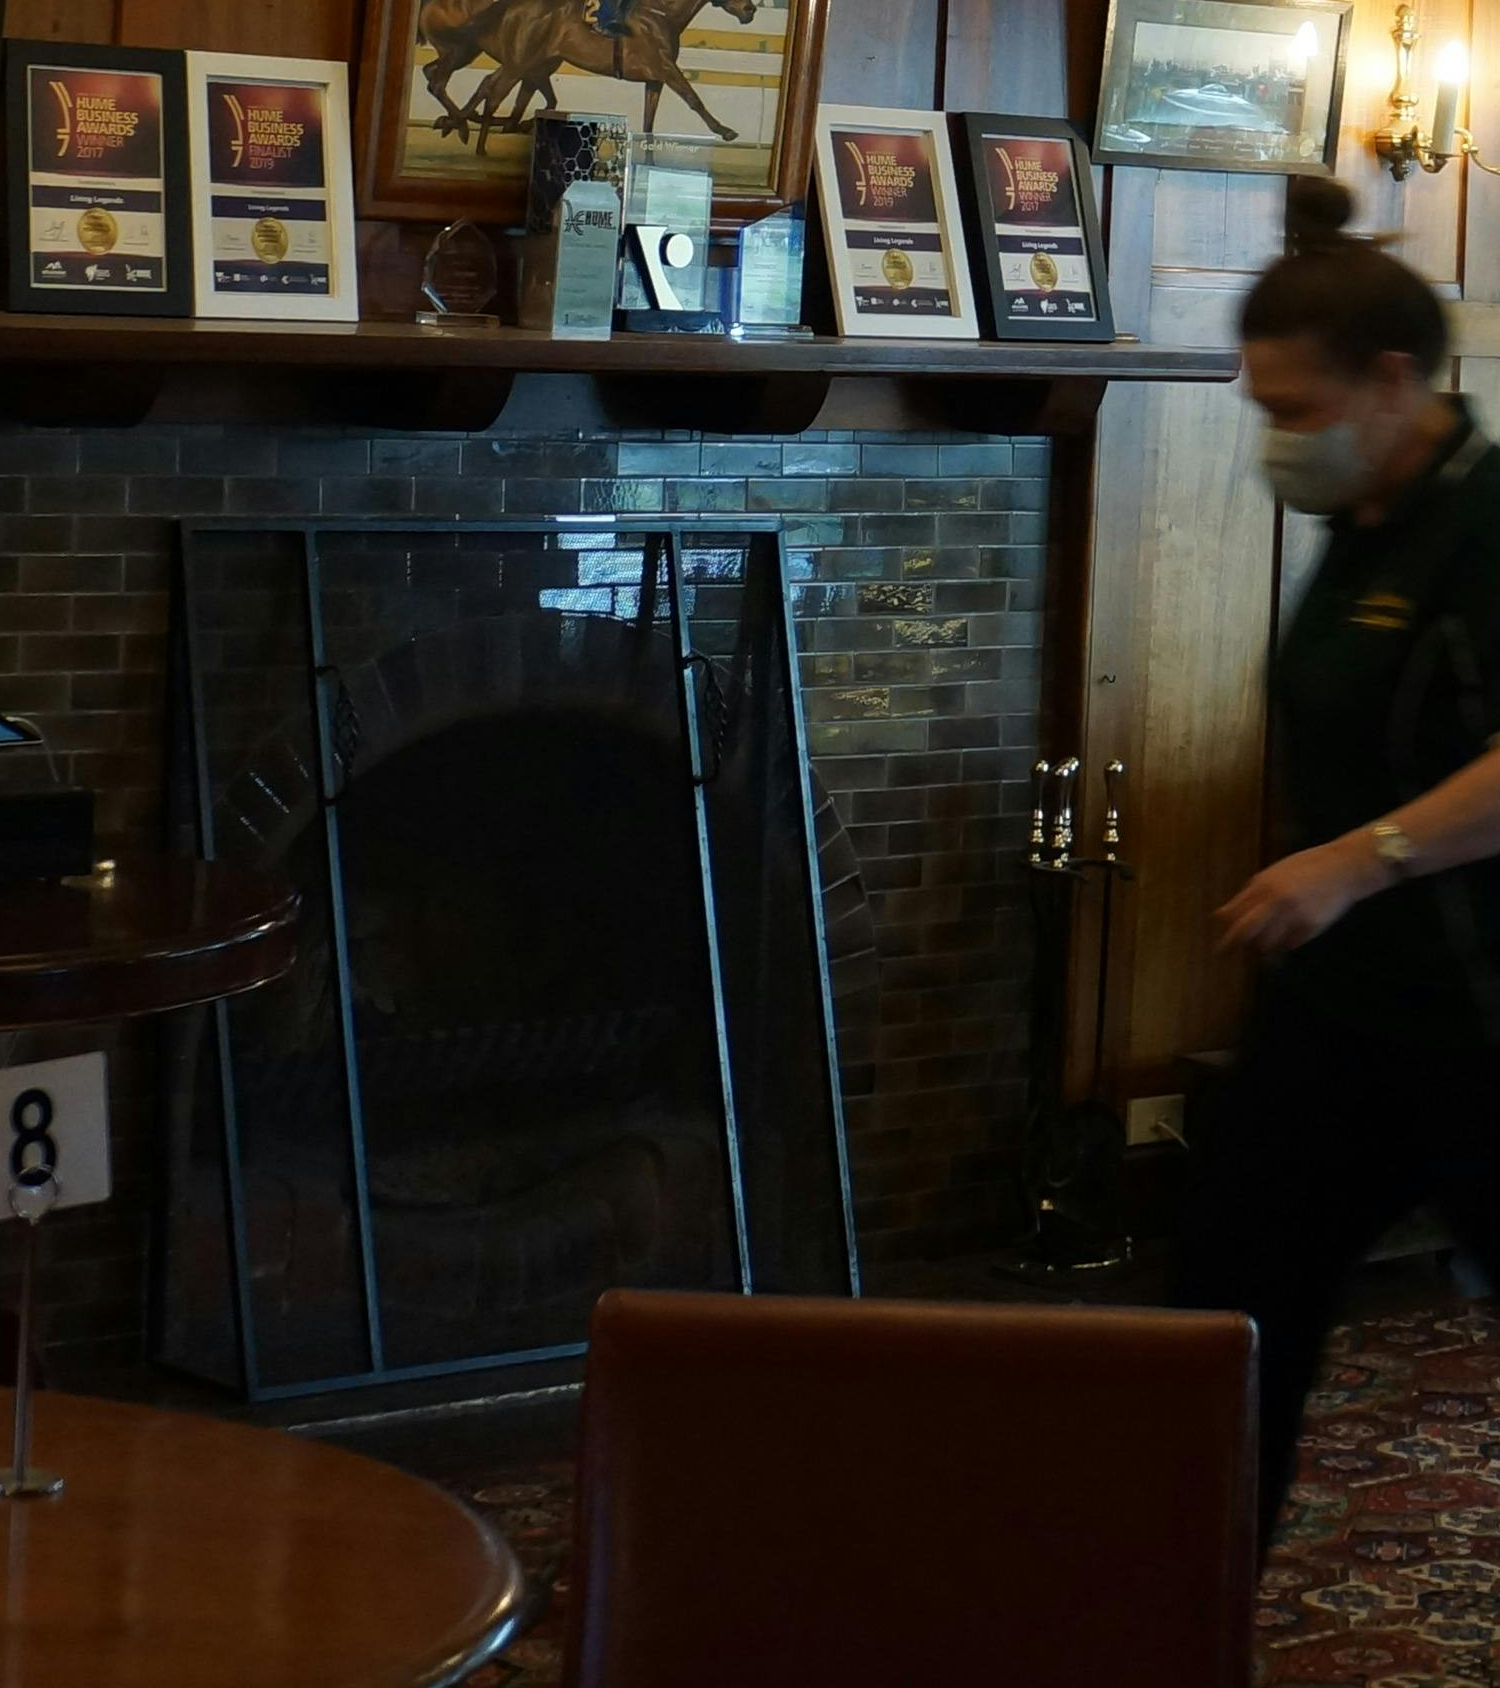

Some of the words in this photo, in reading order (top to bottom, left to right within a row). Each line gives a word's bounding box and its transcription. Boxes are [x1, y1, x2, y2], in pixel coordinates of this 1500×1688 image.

[76, 97, 117, 111] HUME
[76, 109, 139, 124] BUSINESS
[247, 109, 284, 122] HUME
[76, 121, 135, 137] AWARDS
[247, 121, 304, 136] BUSINESS
[76, 133, 125, 148] WINNER
[248, 133, 301, 147] AWARDS
[76, 146, 104, 159] 2017
[248, 144, 293, 159] FINALIST
[866, 155, 898, 166] HUME
[1015, 159, 1043, 171] HUME
[868, 165, 916, 178] BUSINESS
[1016, 170, 1059, 183] BUSINESS
[870, 175, 914, 188] AWARDS
[1018, 181, 1058, 193] AWARDS
[871, 186, 908, 198] WINNER
[1019, 191, 1053, 202] WINNER
[584, 210, 614, 227] HUME
[10, 1087, 57, 1187] 8
